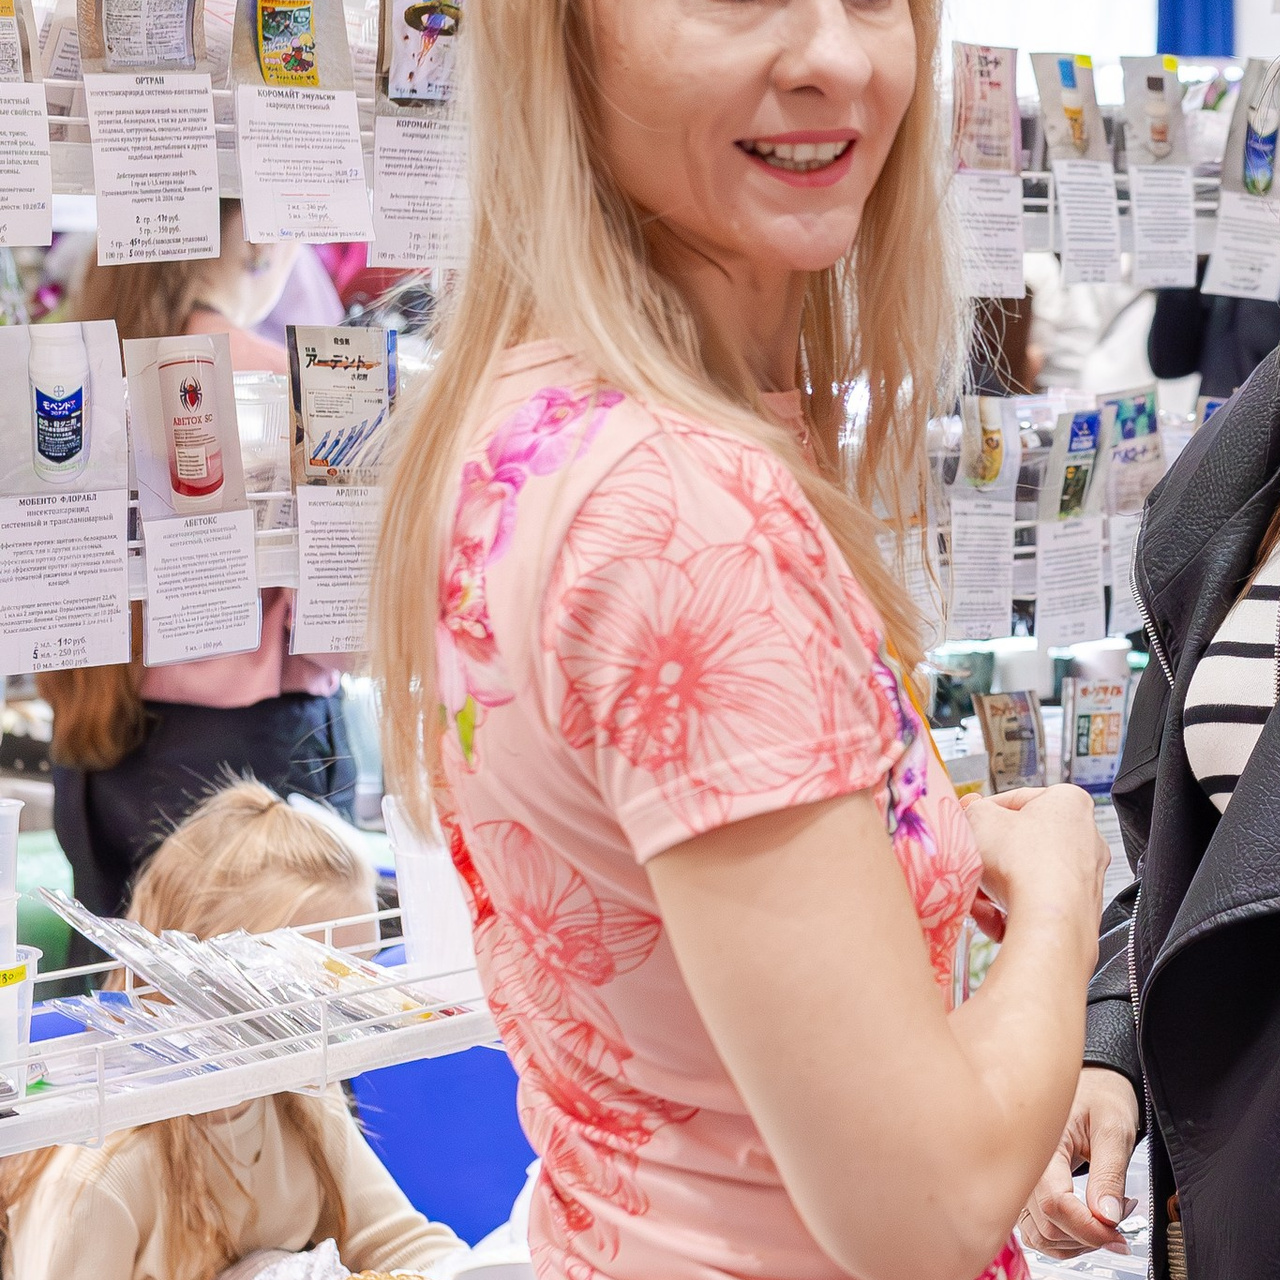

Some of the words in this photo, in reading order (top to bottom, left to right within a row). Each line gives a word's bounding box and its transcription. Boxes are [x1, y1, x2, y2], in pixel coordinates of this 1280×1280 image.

[135, 76, 164, 84] ОРТРАН
[257, 87, 300, 99] КОРОМАЙТ
[10, 106, 42, 116] свойства
[396, 120, 436, 129] КОРОМАЙТ
[173, 416, 202, 426] ABETOX
[205, 414, 213, 422] SC
[18, 495, 57, 508] МОБЕНТО
[60, 491, 96, 504] ФЛОРАБЛ
[1, 518, 42, 531] системный
[184, 516, 216, 527] АБЕТОКС
[32, 649, 38, 659] 5
[58, 648, 72, 657] 250
[33, 662, 41, 670] 10
